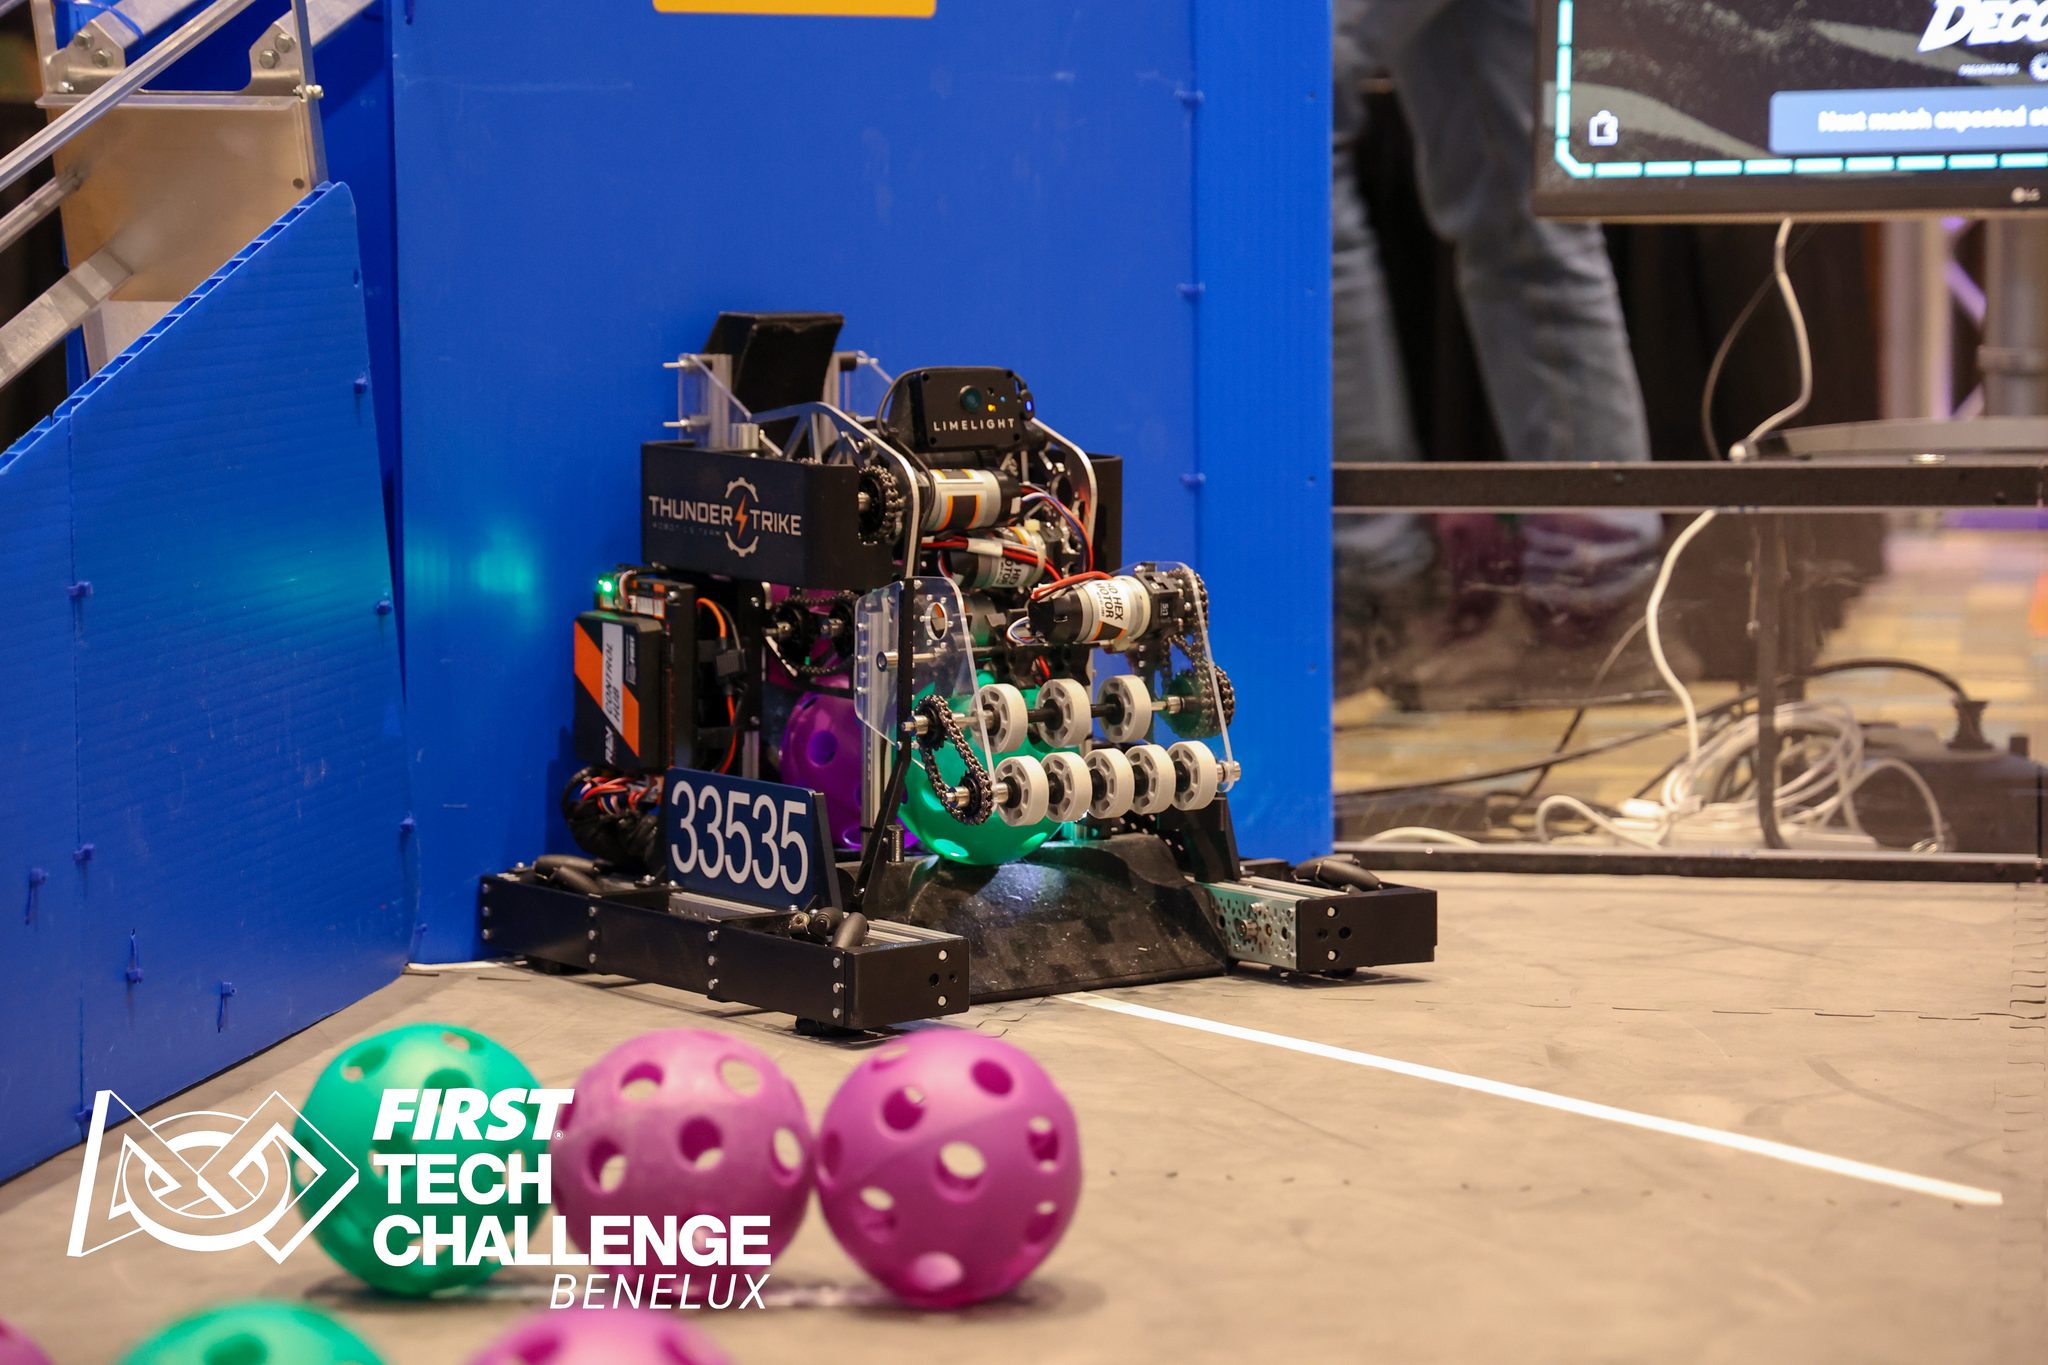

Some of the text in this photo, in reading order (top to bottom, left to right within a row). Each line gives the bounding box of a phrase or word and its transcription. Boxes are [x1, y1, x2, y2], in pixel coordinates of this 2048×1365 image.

[933, 417, 1016, 432] LIMELIGHT
[648, 495, 733, 527] THUNDER
[1097, 583, 1115, 618] MOTOR
[1112, 596, 1124, 620] HEX
[604, 642, 613, 716] CONTROL
[671, 780, 809, 895] 33535
